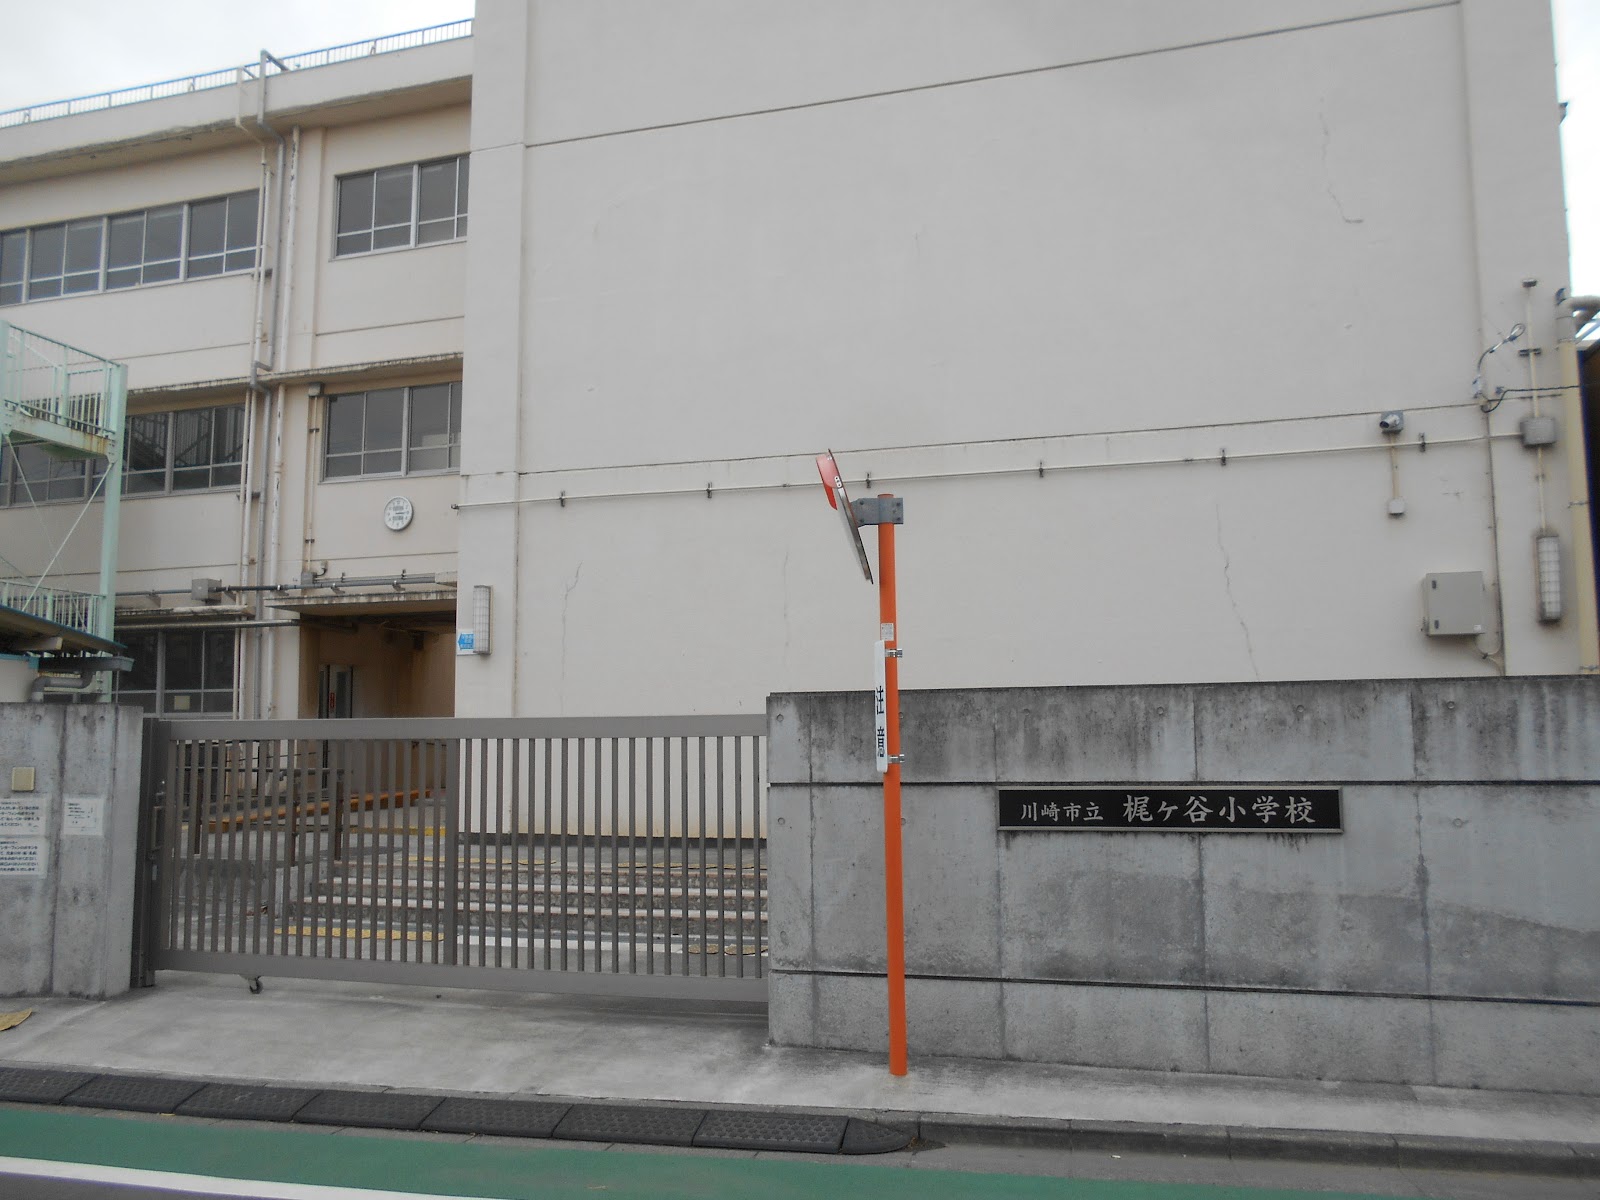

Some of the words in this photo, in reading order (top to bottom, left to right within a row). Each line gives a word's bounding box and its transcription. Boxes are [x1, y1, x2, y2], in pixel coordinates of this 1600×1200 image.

[875, 685, 885, 758] 注意
[1021, 801, 1104, 822] 川崎市立
[1122, 794, 1316, 823] 梶ヶ谷小学校
